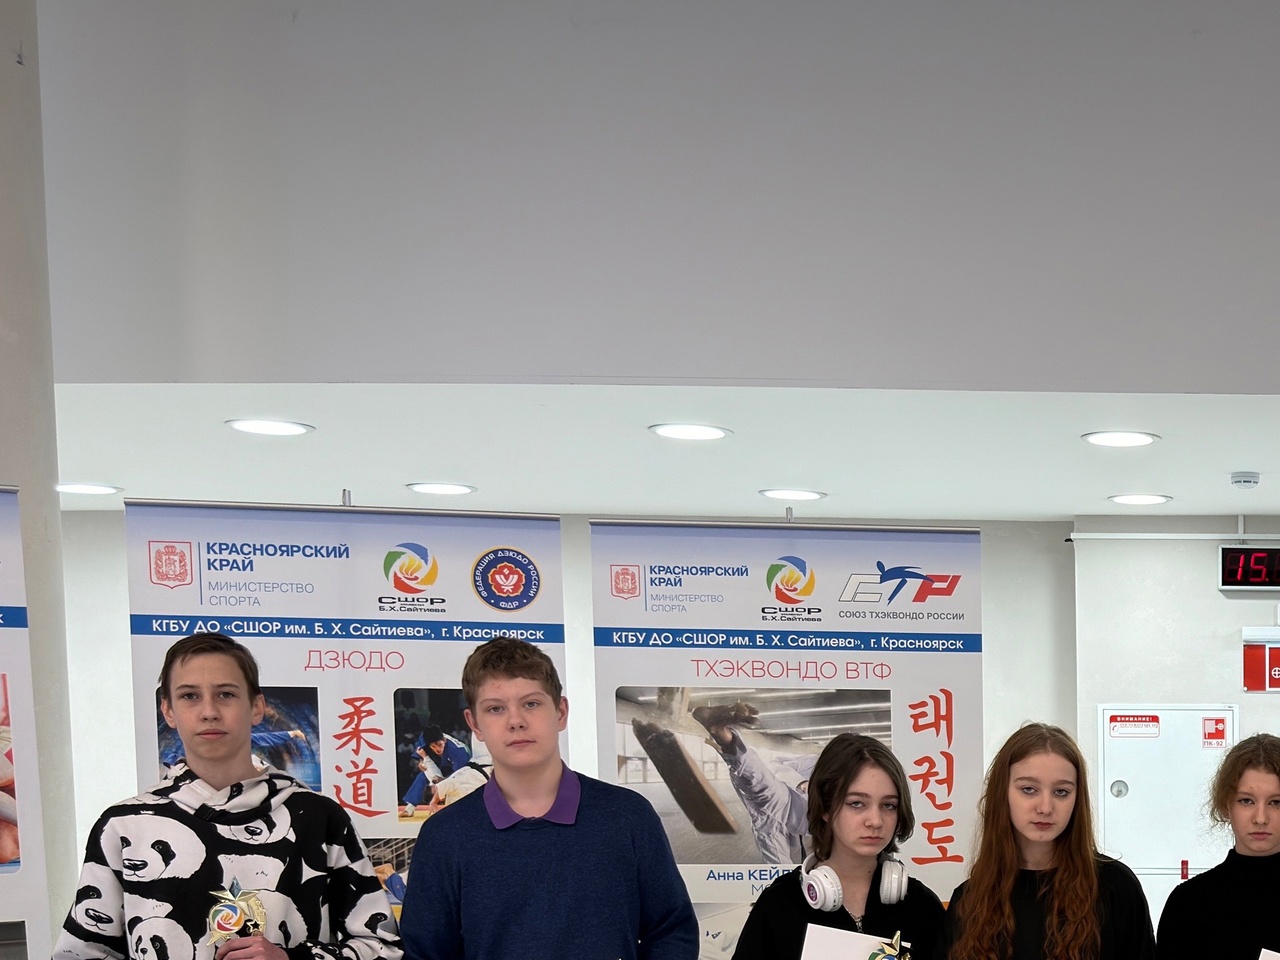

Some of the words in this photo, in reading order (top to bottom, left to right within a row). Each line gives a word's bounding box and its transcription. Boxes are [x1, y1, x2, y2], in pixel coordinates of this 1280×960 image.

[206, 541, 350, 559] КРАСНОЯРСКИЙ
[207, 556, 254, 572] КРАЙ
[649, 565, 749, 577] КРАСНОЯРСКИЙ
[475, 553, 496, 597] ФЕДЕРАЦИЯ
[497, 550, 529, 564] ДЗЮДО
[527, 564, 539, 597] РОССИИ
[208, 581, 315, 594] МИНИСТЕРСТВО
[649, 575, 683, 587] КРАЙ
[209, 595, 261, 607] СПОРТА
[499, 601, 519, 609] ФДР
[650, 594, 724, 603] МИНИСТЕРСТВО
[651, 604, 688, 613] СПОРТА
[838, 610, 867, 619] СОЮЗ
[869, 610, 925, 621] ТХЭКВОНДО
[926, 612, 965, 621] РОССИИ
[152, 619, 191, 633] КГБУ
[193, 620, 221, 635] ДО
[224, 621, 281, 635] «СШОР
[284, 624, 311, 635] им.
[314, 623, 328, 635] Б.
[331, 623, 351, 636] Х.
[352, 622, 435, 640] Сайтиева»,
[441, 627, 451, 638] г.
[453, 625, 545, 641] Красноярск
[612, 631, 646, 644] КГБУ
[649, 632, 673, 646] ДО
[676, 632, 727, 645] «СШОР
[729, 635, 753, 646] им.
[756, 634, 768, 646] Б.
[771, 634, 784, 646] Х.
[787, 634, 865, 649] Сайтиева»,
[870, 638, 878, 648] г.
[881, 636, 964, 651] Красноярск
[304, 650, 405, 672] ДЗЮДО
[690, 659, 838, 682] ТХЭКВОНДО
[844, 660, 892, 681] ВТФ
[331, 696, 391, 819] 柔道
[907, 687, 965, 867] 태권도
[706, 869, 744, 881] Анна
